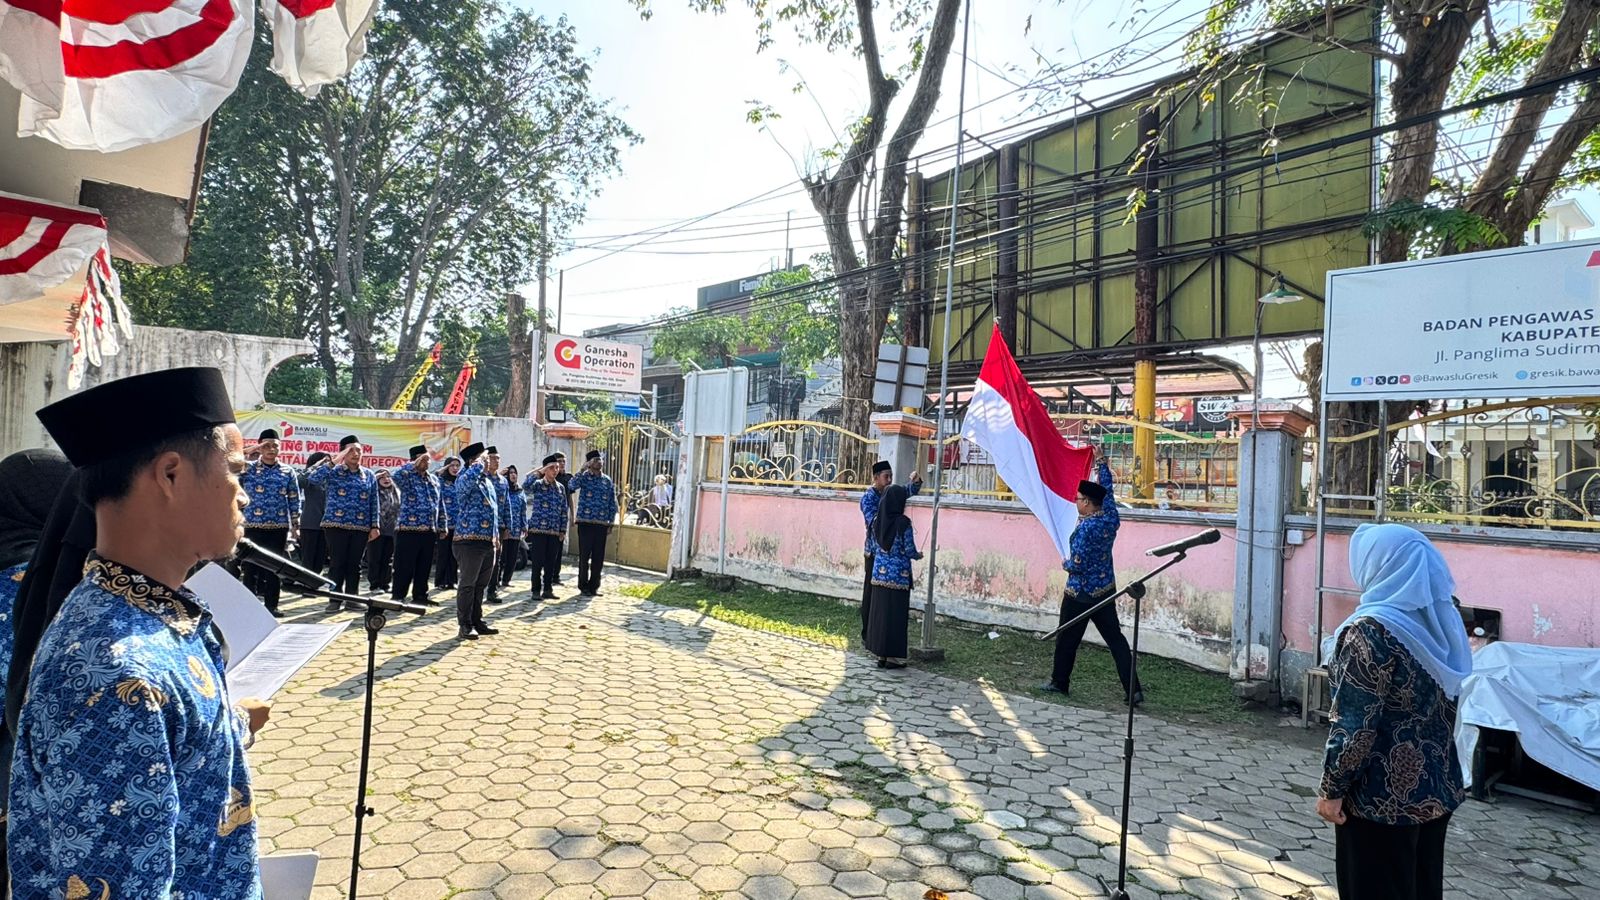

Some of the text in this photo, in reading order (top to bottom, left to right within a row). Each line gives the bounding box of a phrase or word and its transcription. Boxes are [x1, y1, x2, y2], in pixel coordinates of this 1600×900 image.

[1423, 309, 1594, 332] BADAN PENGAWAS
[1501, 325, 1600, 343] KABUPATE
[584, 344, 628, 358] Ganesha
[1434, 342, 1600, 364] Jl. Panglima Sudirm
[584, 355, 635, 369] Operation
[1413, 367, 1600, 383] @BawasluGresik gresik.bawa
[294, 425, 328, 433] BAWASLU
